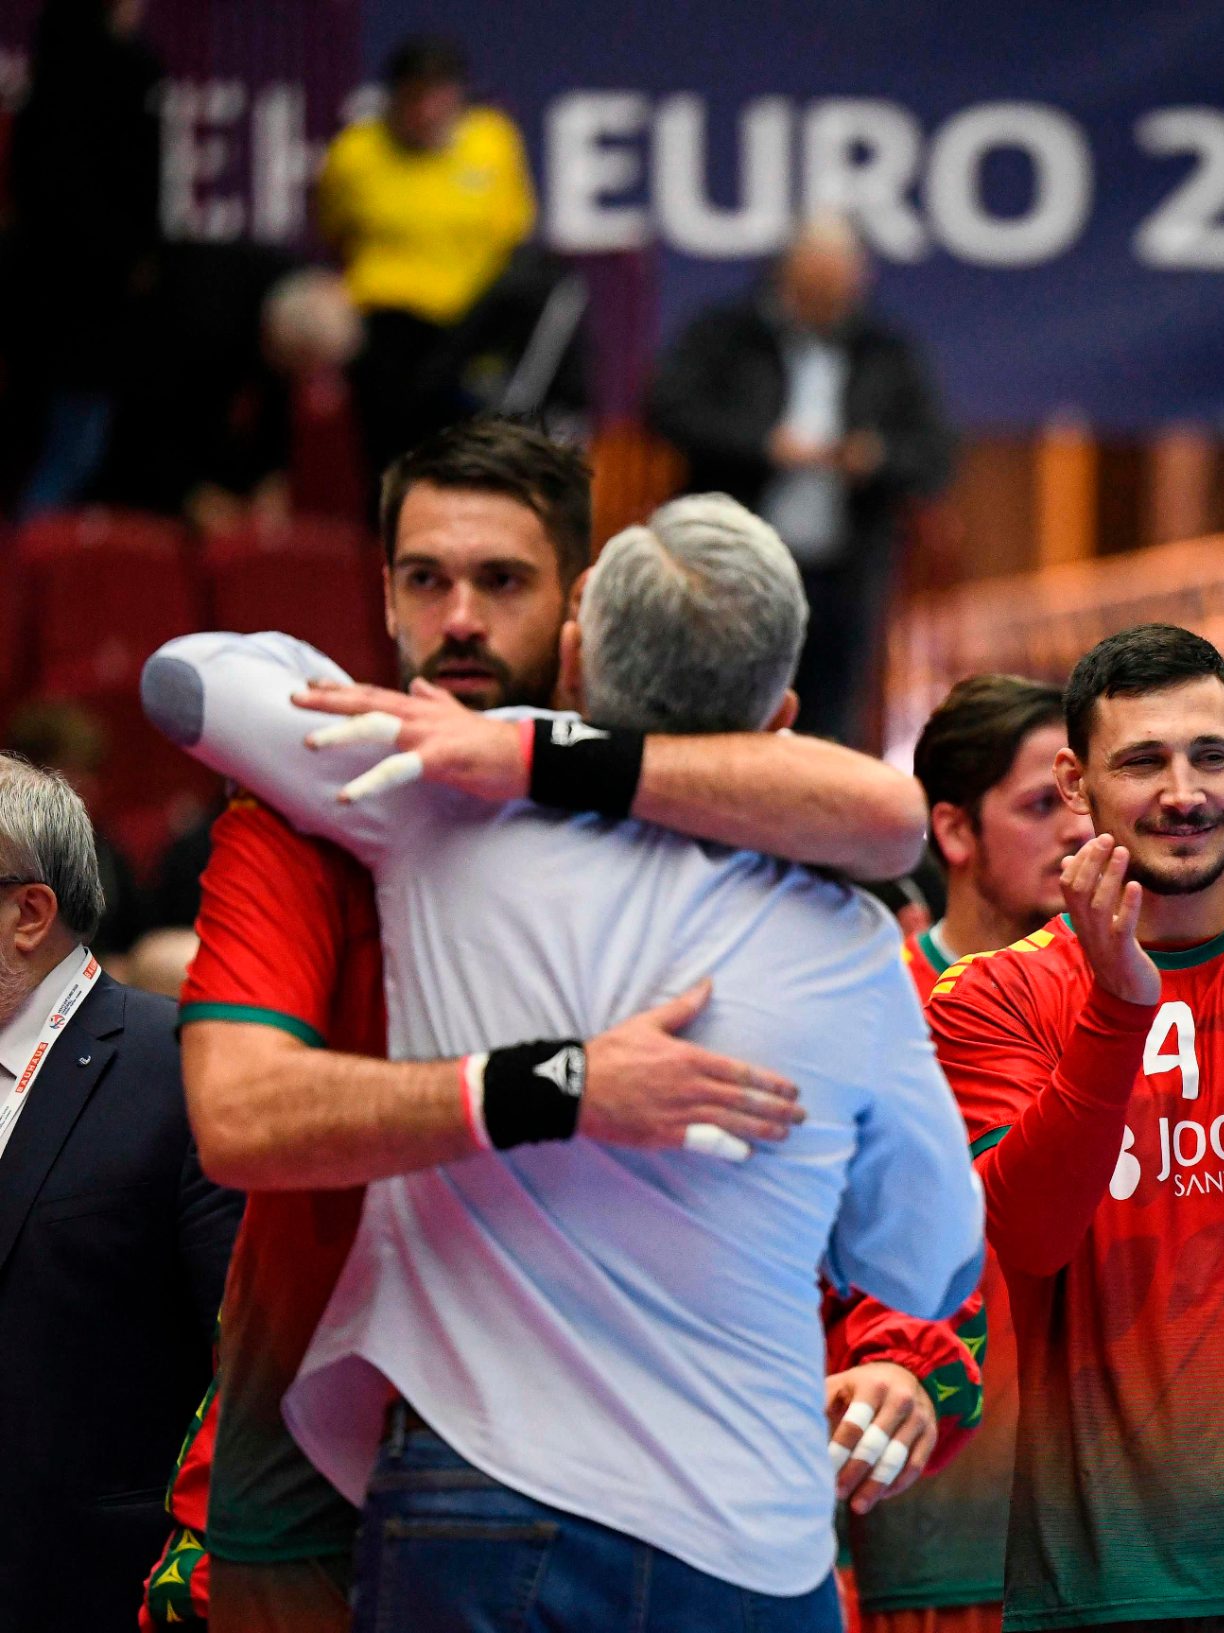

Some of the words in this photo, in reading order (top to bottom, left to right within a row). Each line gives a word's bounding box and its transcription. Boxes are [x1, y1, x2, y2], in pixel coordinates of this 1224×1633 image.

[544, 90, 1094, 268] EURO
[16, 1042, 48, 1092] BAUHAUS
[1143, 1000, 1199, 1099] 4
